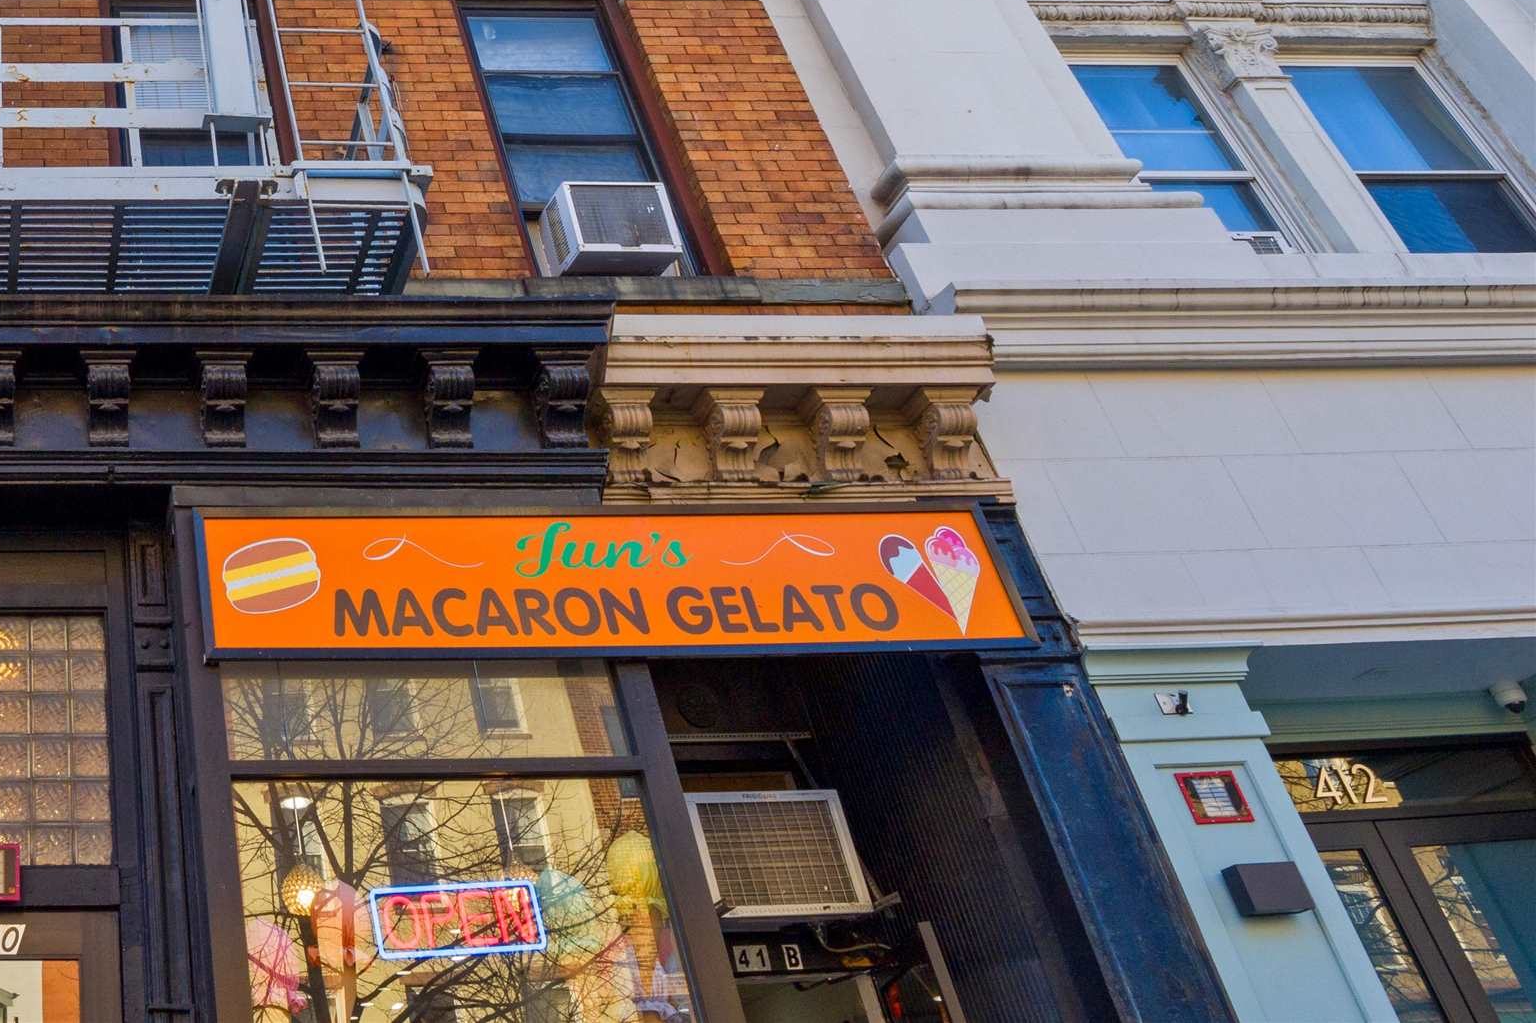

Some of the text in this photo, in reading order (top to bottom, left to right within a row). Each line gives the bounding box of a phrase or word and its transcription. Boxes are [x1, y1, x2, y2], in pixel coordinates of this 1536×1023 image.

[516, 522, 692, 577] Jun's
[334, 583, 899, 637] MACARON GELATO
[1316, 764, 1388, 804] 412
[383, 888, 538, 949] OPEN
[738, 946, 800, 968] 41 B
